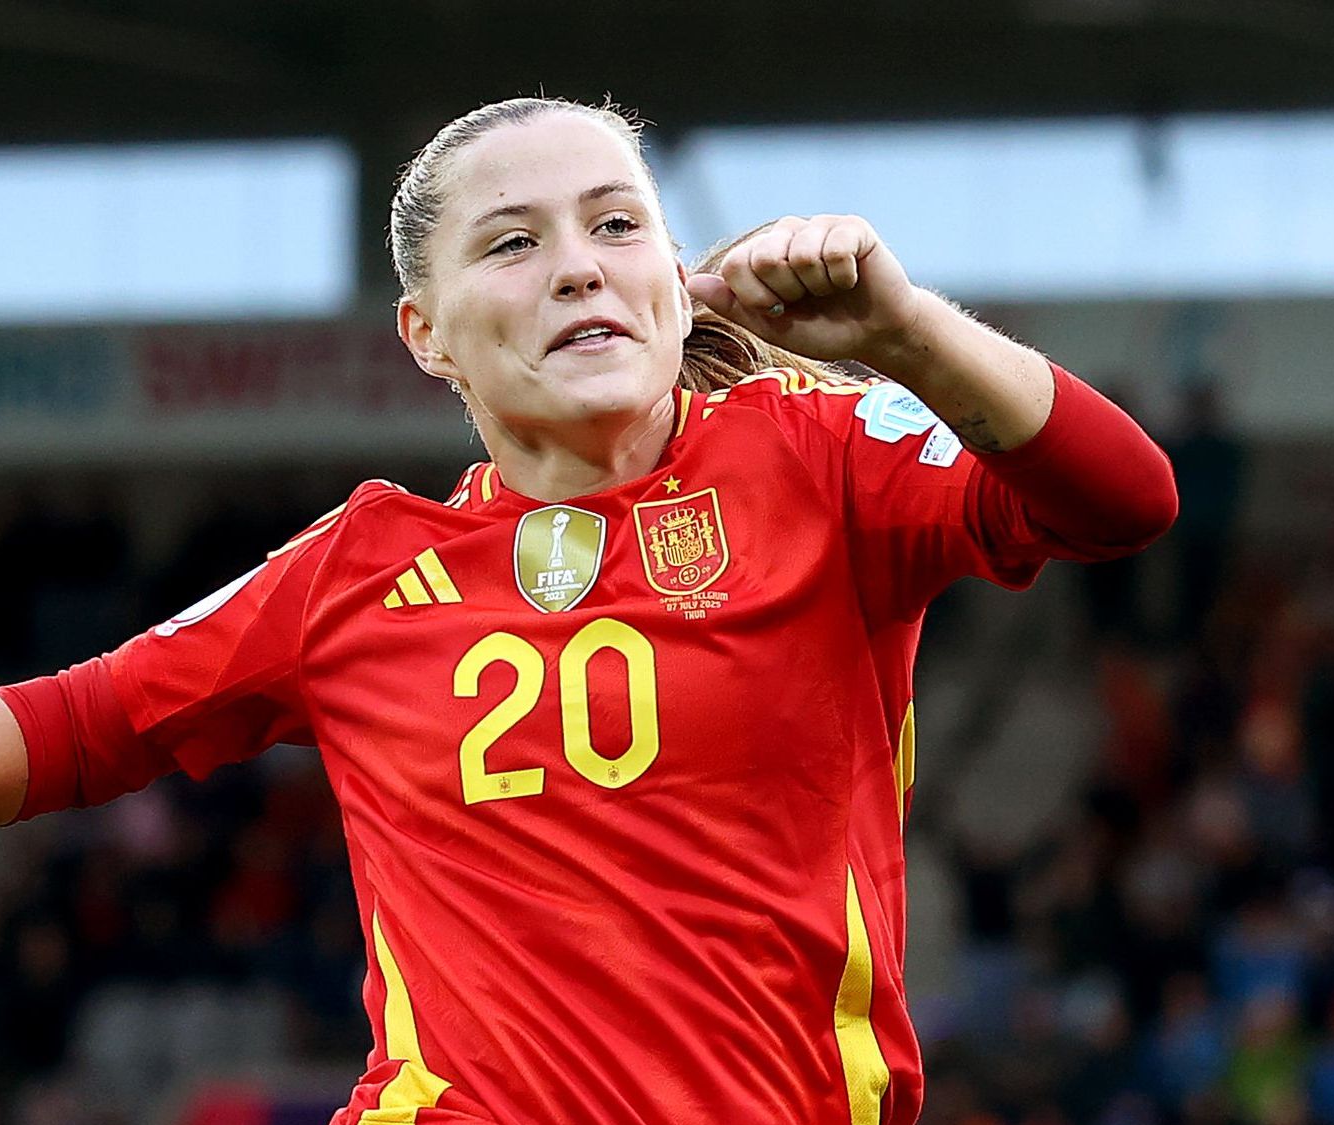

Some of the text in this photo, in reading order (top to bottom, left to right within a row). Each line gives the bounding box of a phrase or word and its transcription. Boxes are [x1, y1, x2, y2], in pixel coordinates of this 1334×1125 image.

[537, 570, 575, 587] FIFA
[543, 591, 566, 602] 2023
[692, 591, 729, 601] BELGIUM
[666, 600, 721, 612] 07 JULY 2025
[684, 609, 706, 620] THUN
[453, 617, 660, 805] 20
